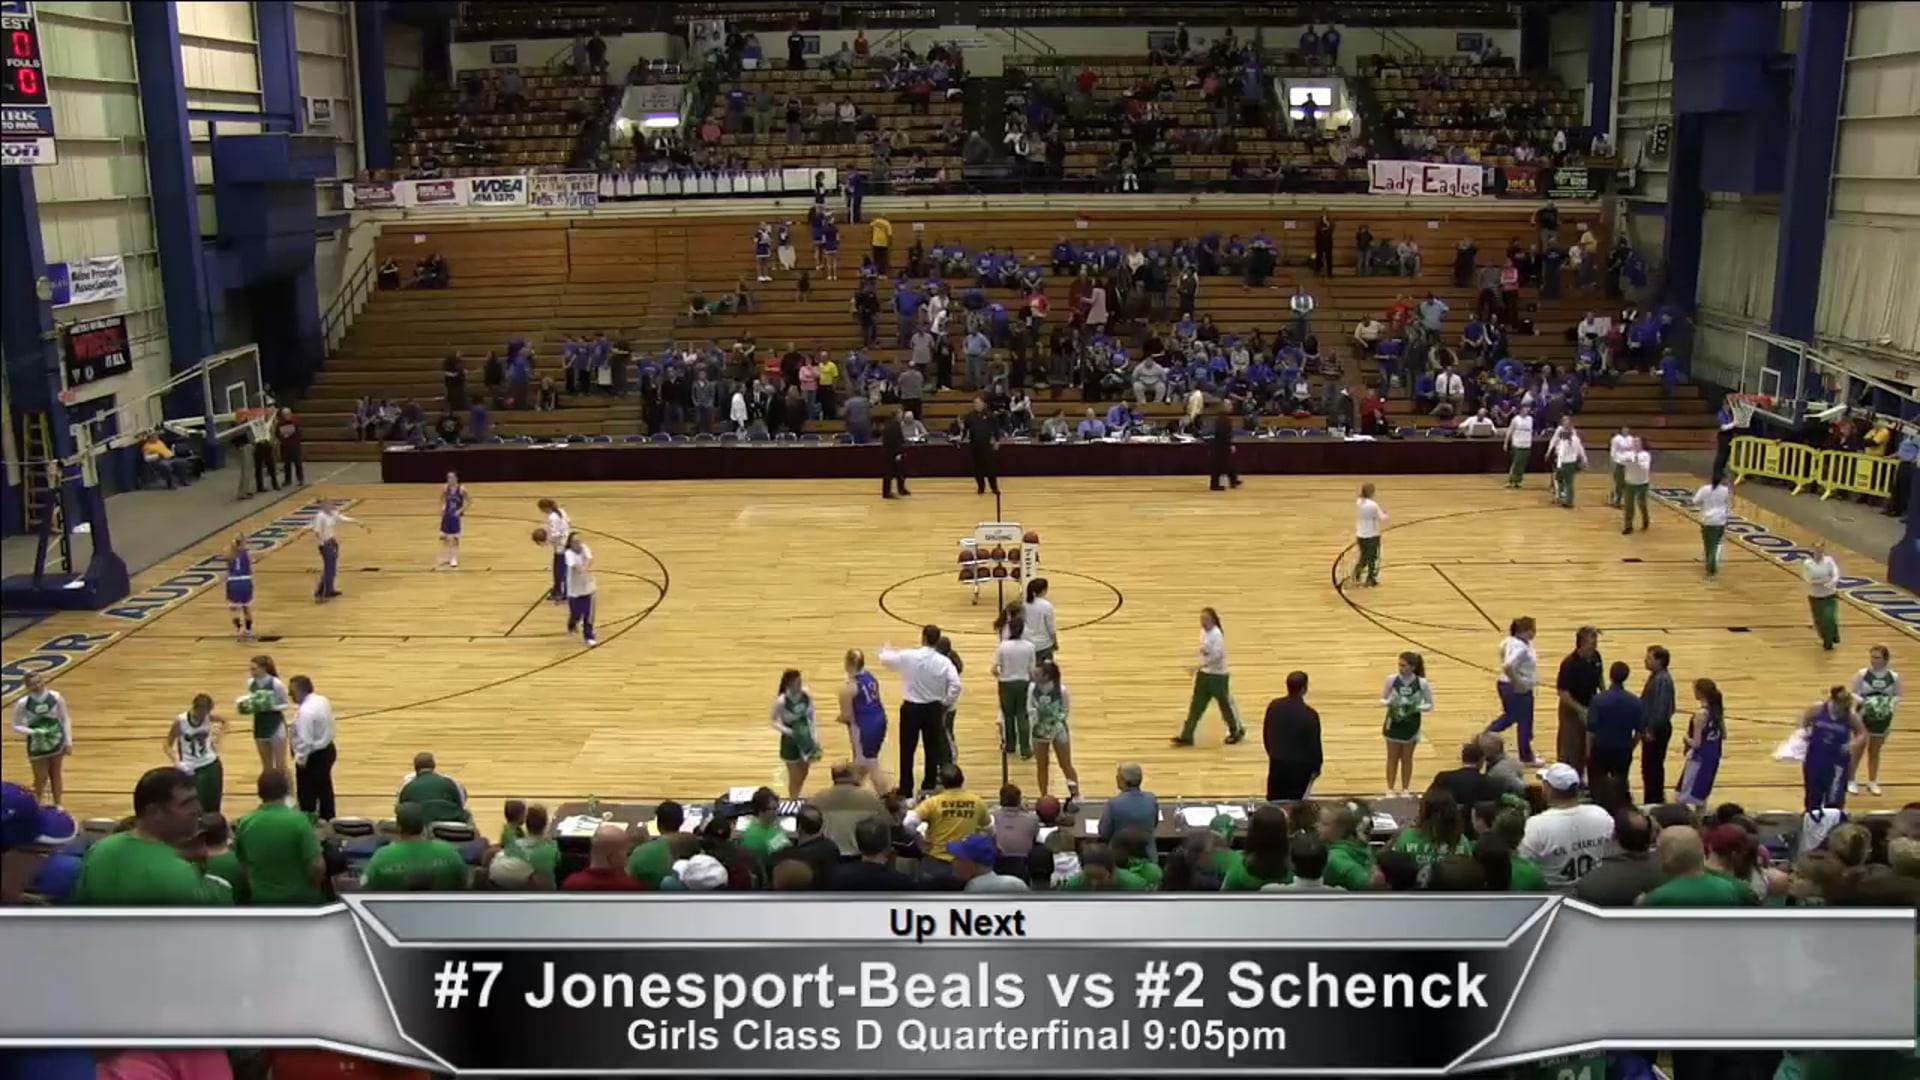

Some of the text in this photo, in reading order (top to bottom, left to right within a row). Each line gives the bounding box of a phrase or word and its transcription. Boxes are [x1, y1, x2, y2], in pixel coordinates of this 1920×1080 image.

[12, 31, 31, 57] 0
[7, 58, 40, 67] FOULS
[18, 68, 38, 94] 0
[472, 179, 522, 193] WDEA
[1372, 163, 1480, 197] Lady Eagles
[473, 192, 492, 202] AM
[74, 280, 118, 293] Association
[941, 800, 976, 809] EVENT
[942, 810, 976, 818] STAFF
[1560, 855, 1593, 880] 40
